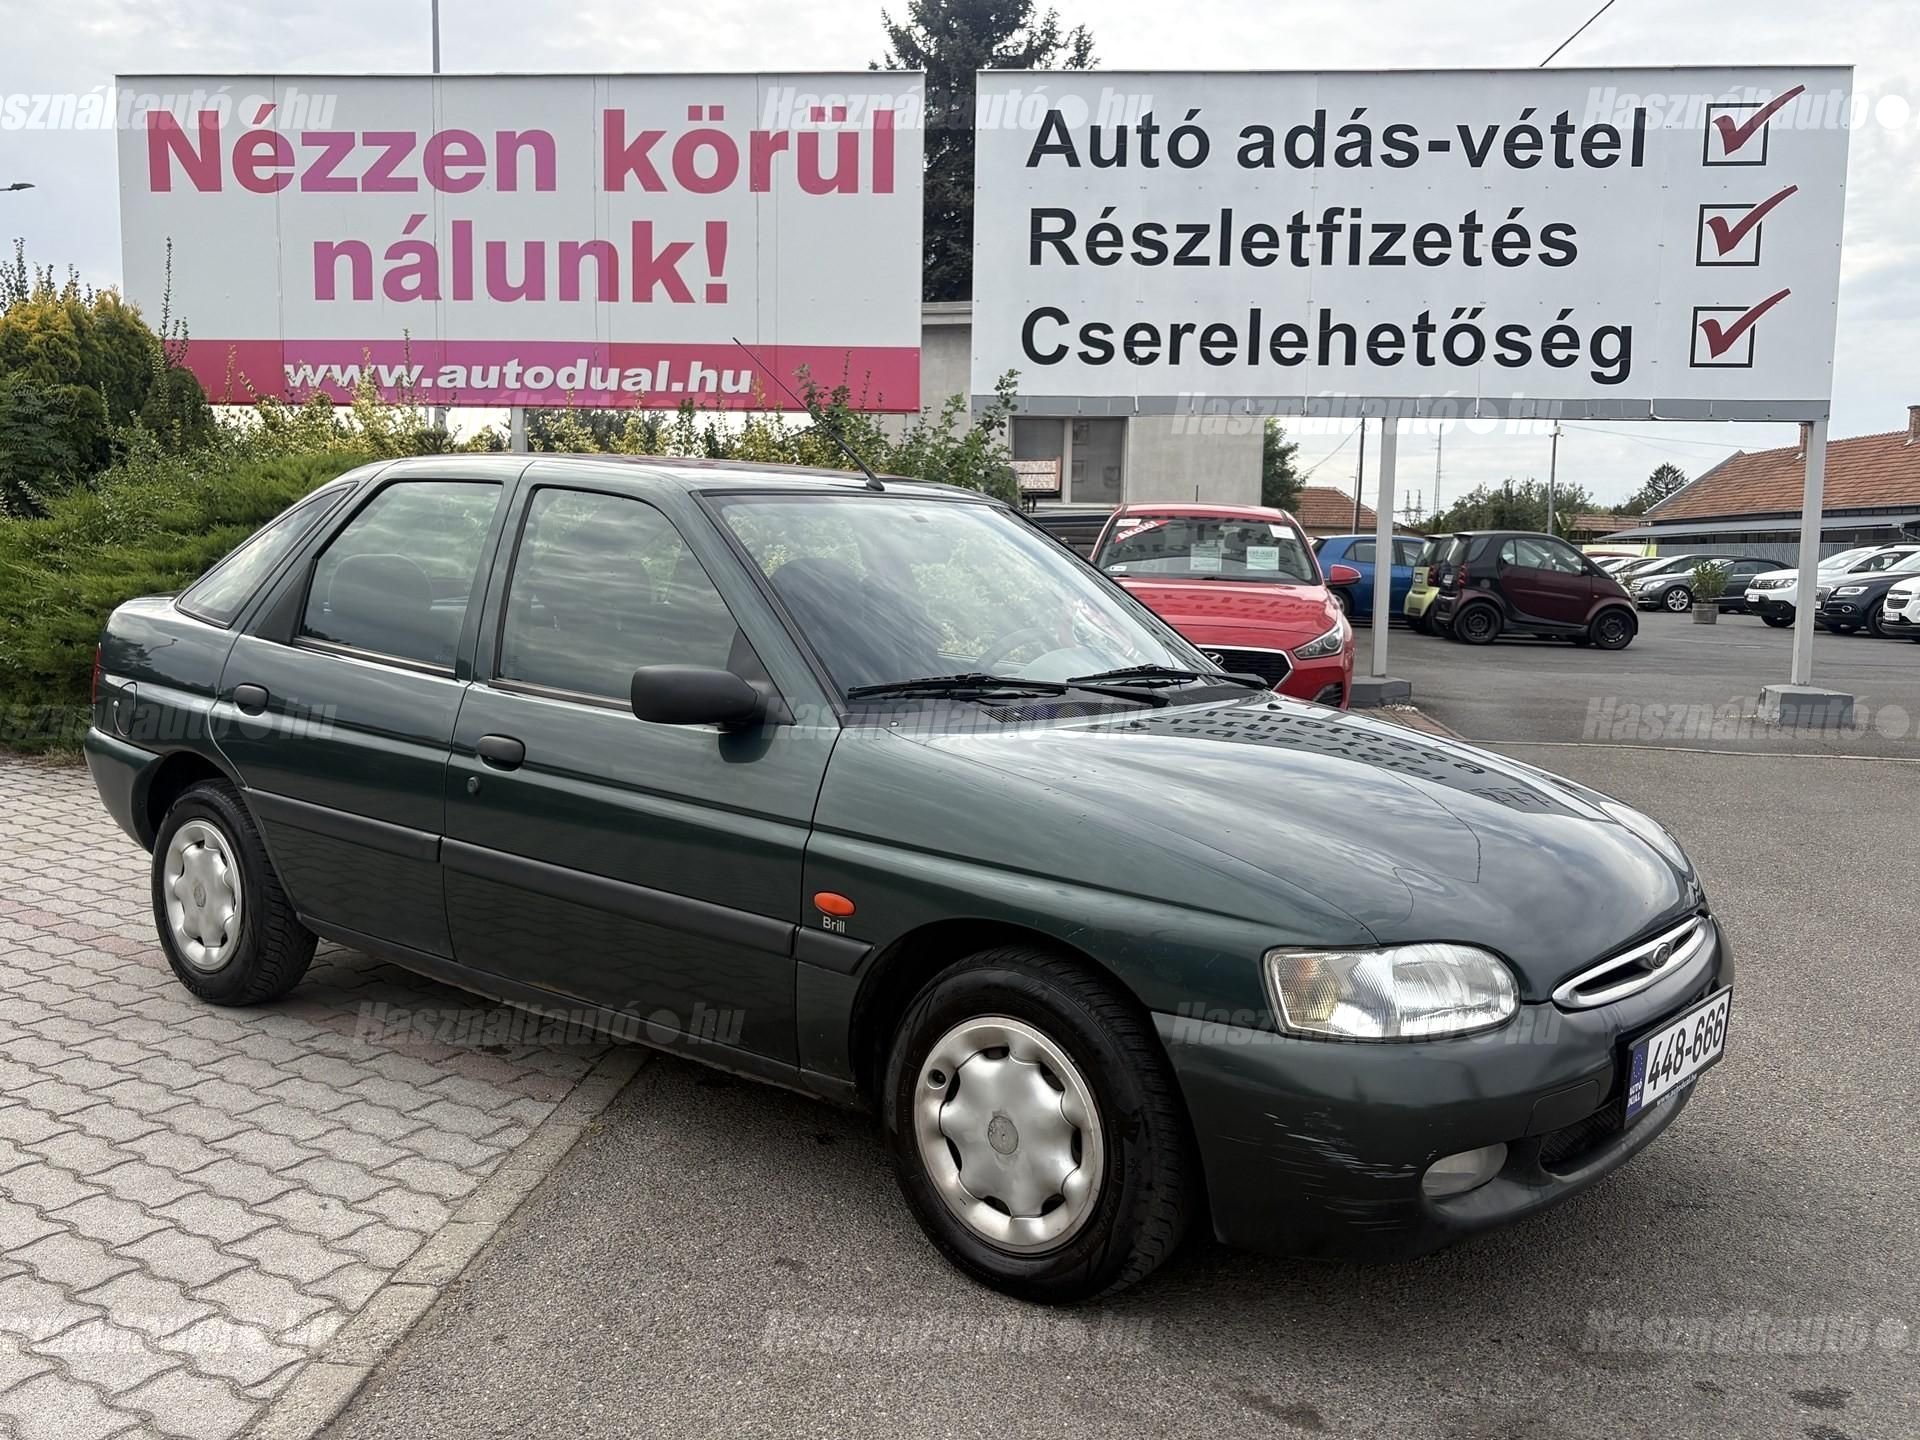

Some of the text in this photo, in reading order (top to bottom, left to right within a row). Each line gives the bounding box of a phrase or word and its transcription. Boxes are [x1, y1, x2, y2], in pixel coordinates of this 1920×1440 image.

[147, 104, 895, 195] Nézzen körül
[1026, 107, 1646, 169] Autó adás-vétel
[314, 214, 728, 304] nálunk!
[1030, 206, 1579, 268] Részletfizetés
[284, 358, 753, 395] www.autodual.hu
[1020, 306, 1632, 386] Cserelehetőség
[822, 915, 845, 934] Brill
[1647, 1002, 1726, 1091] 448-666
